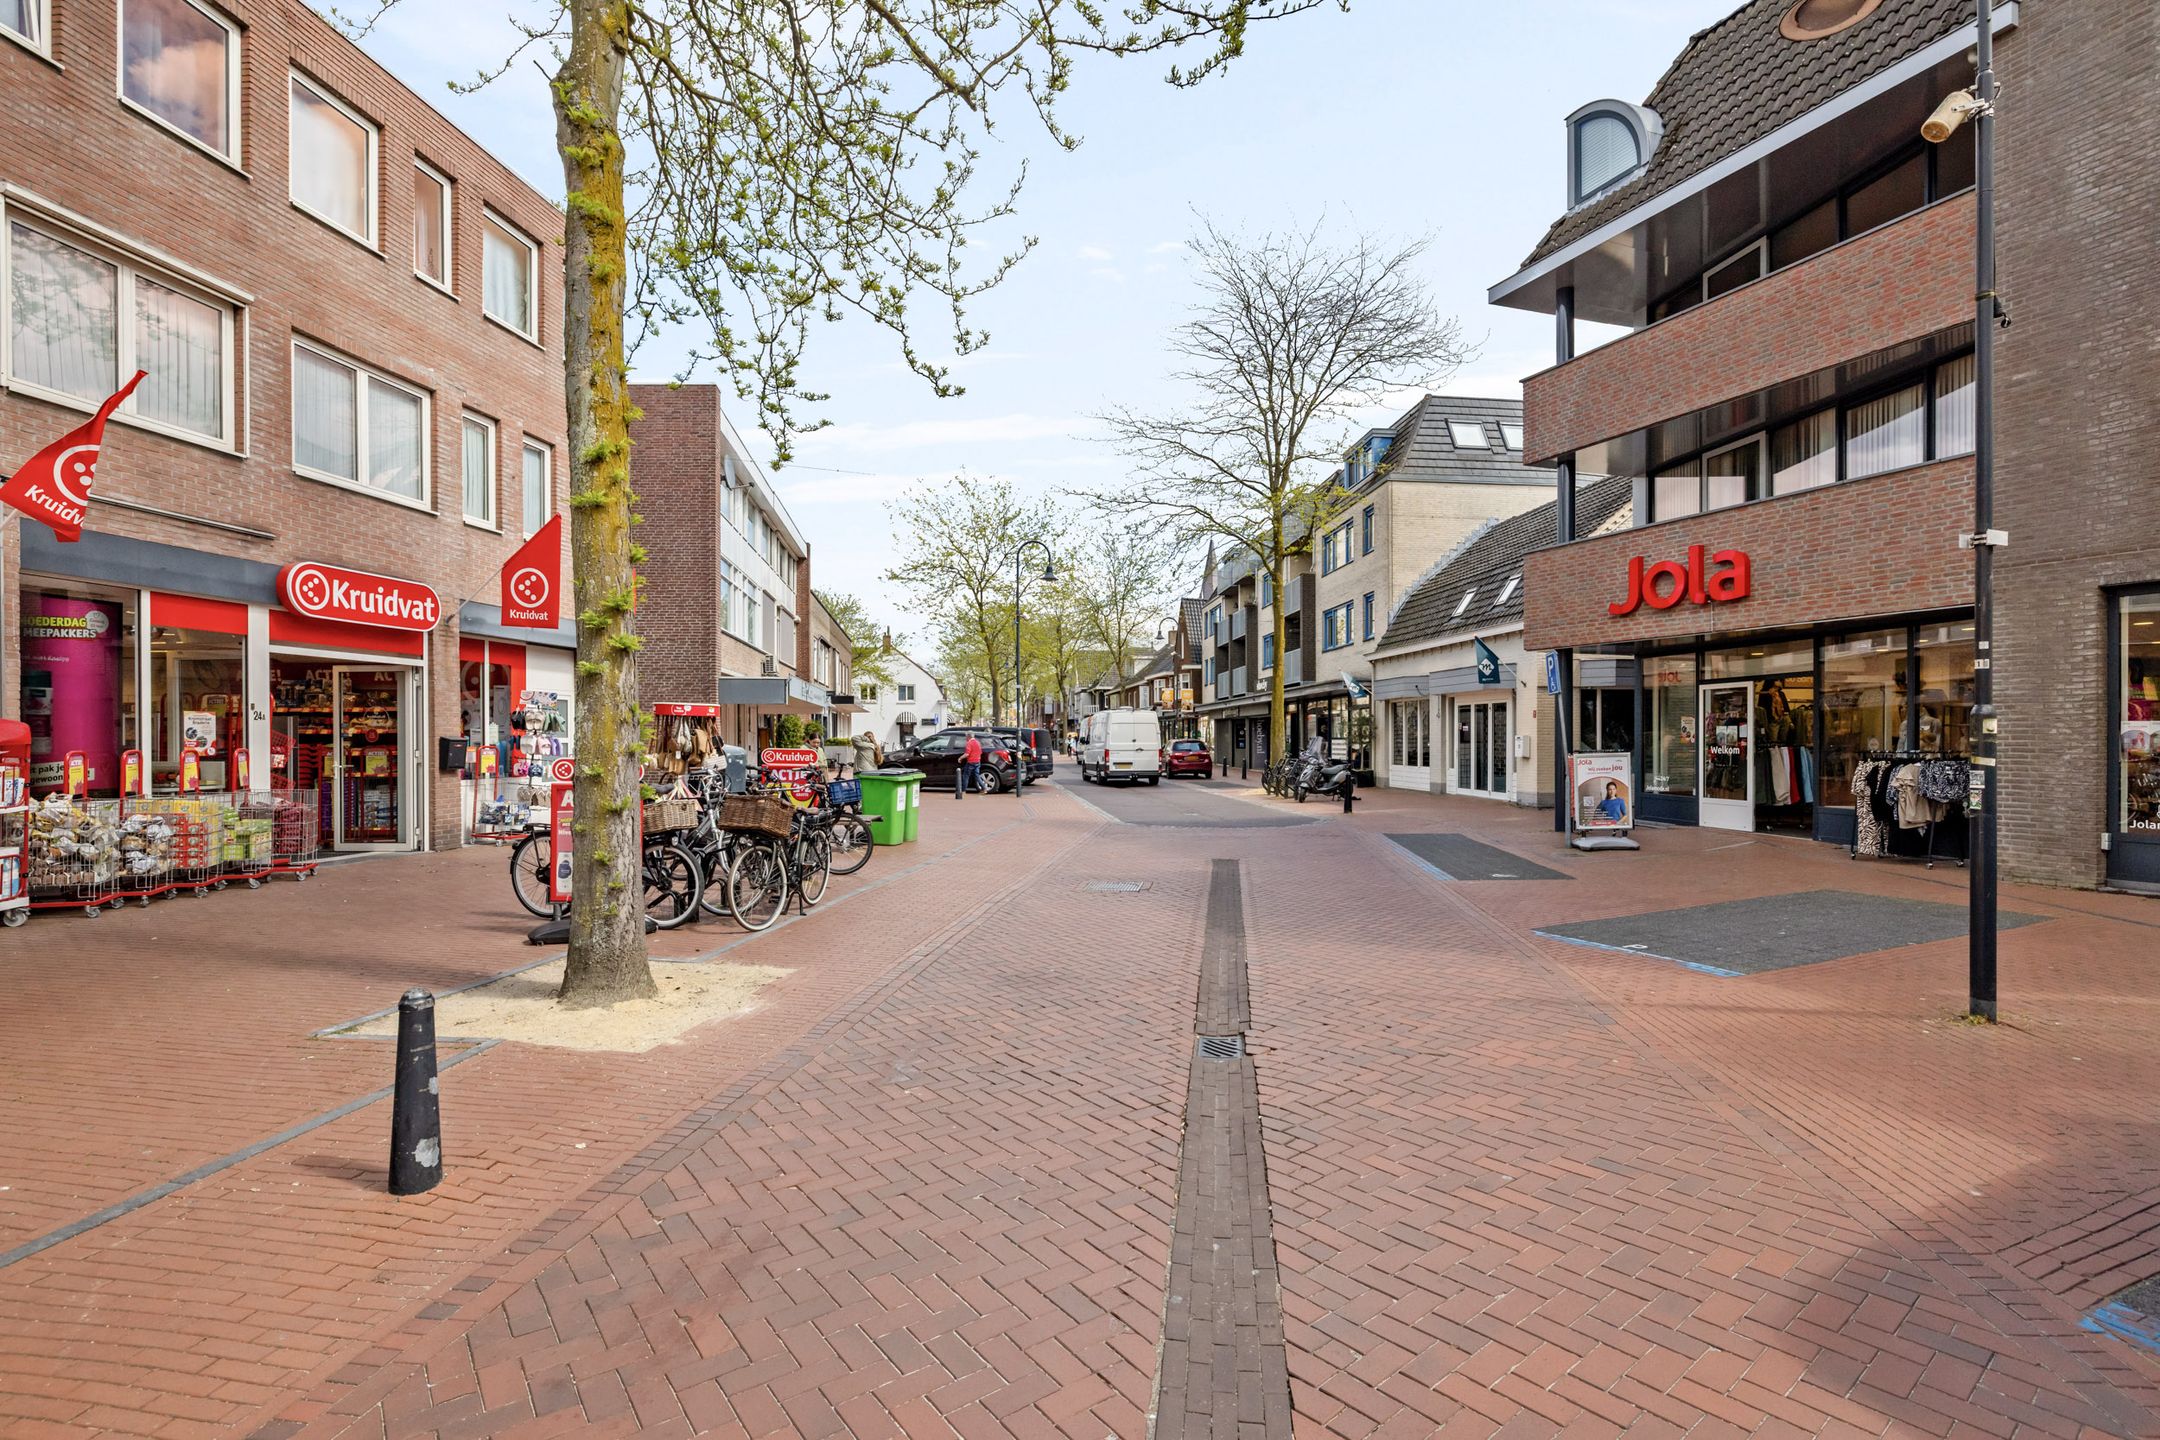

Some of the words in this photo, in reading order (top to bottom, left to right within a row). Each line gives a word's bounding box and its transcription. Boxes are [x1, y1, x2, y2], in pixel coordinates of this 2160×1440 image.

[24, 484, 85, 527] Kruidv
[1608, 544, 1751, 616] Jola
[332, 579, 436, 622] Kruidvat
[509, 608, 549, 621] Kruidvat
[1710, 745, 1740, 755] Welkom
[776, 752, 814, 762] Kruidvat
[38, 765, 55, 774] pak
